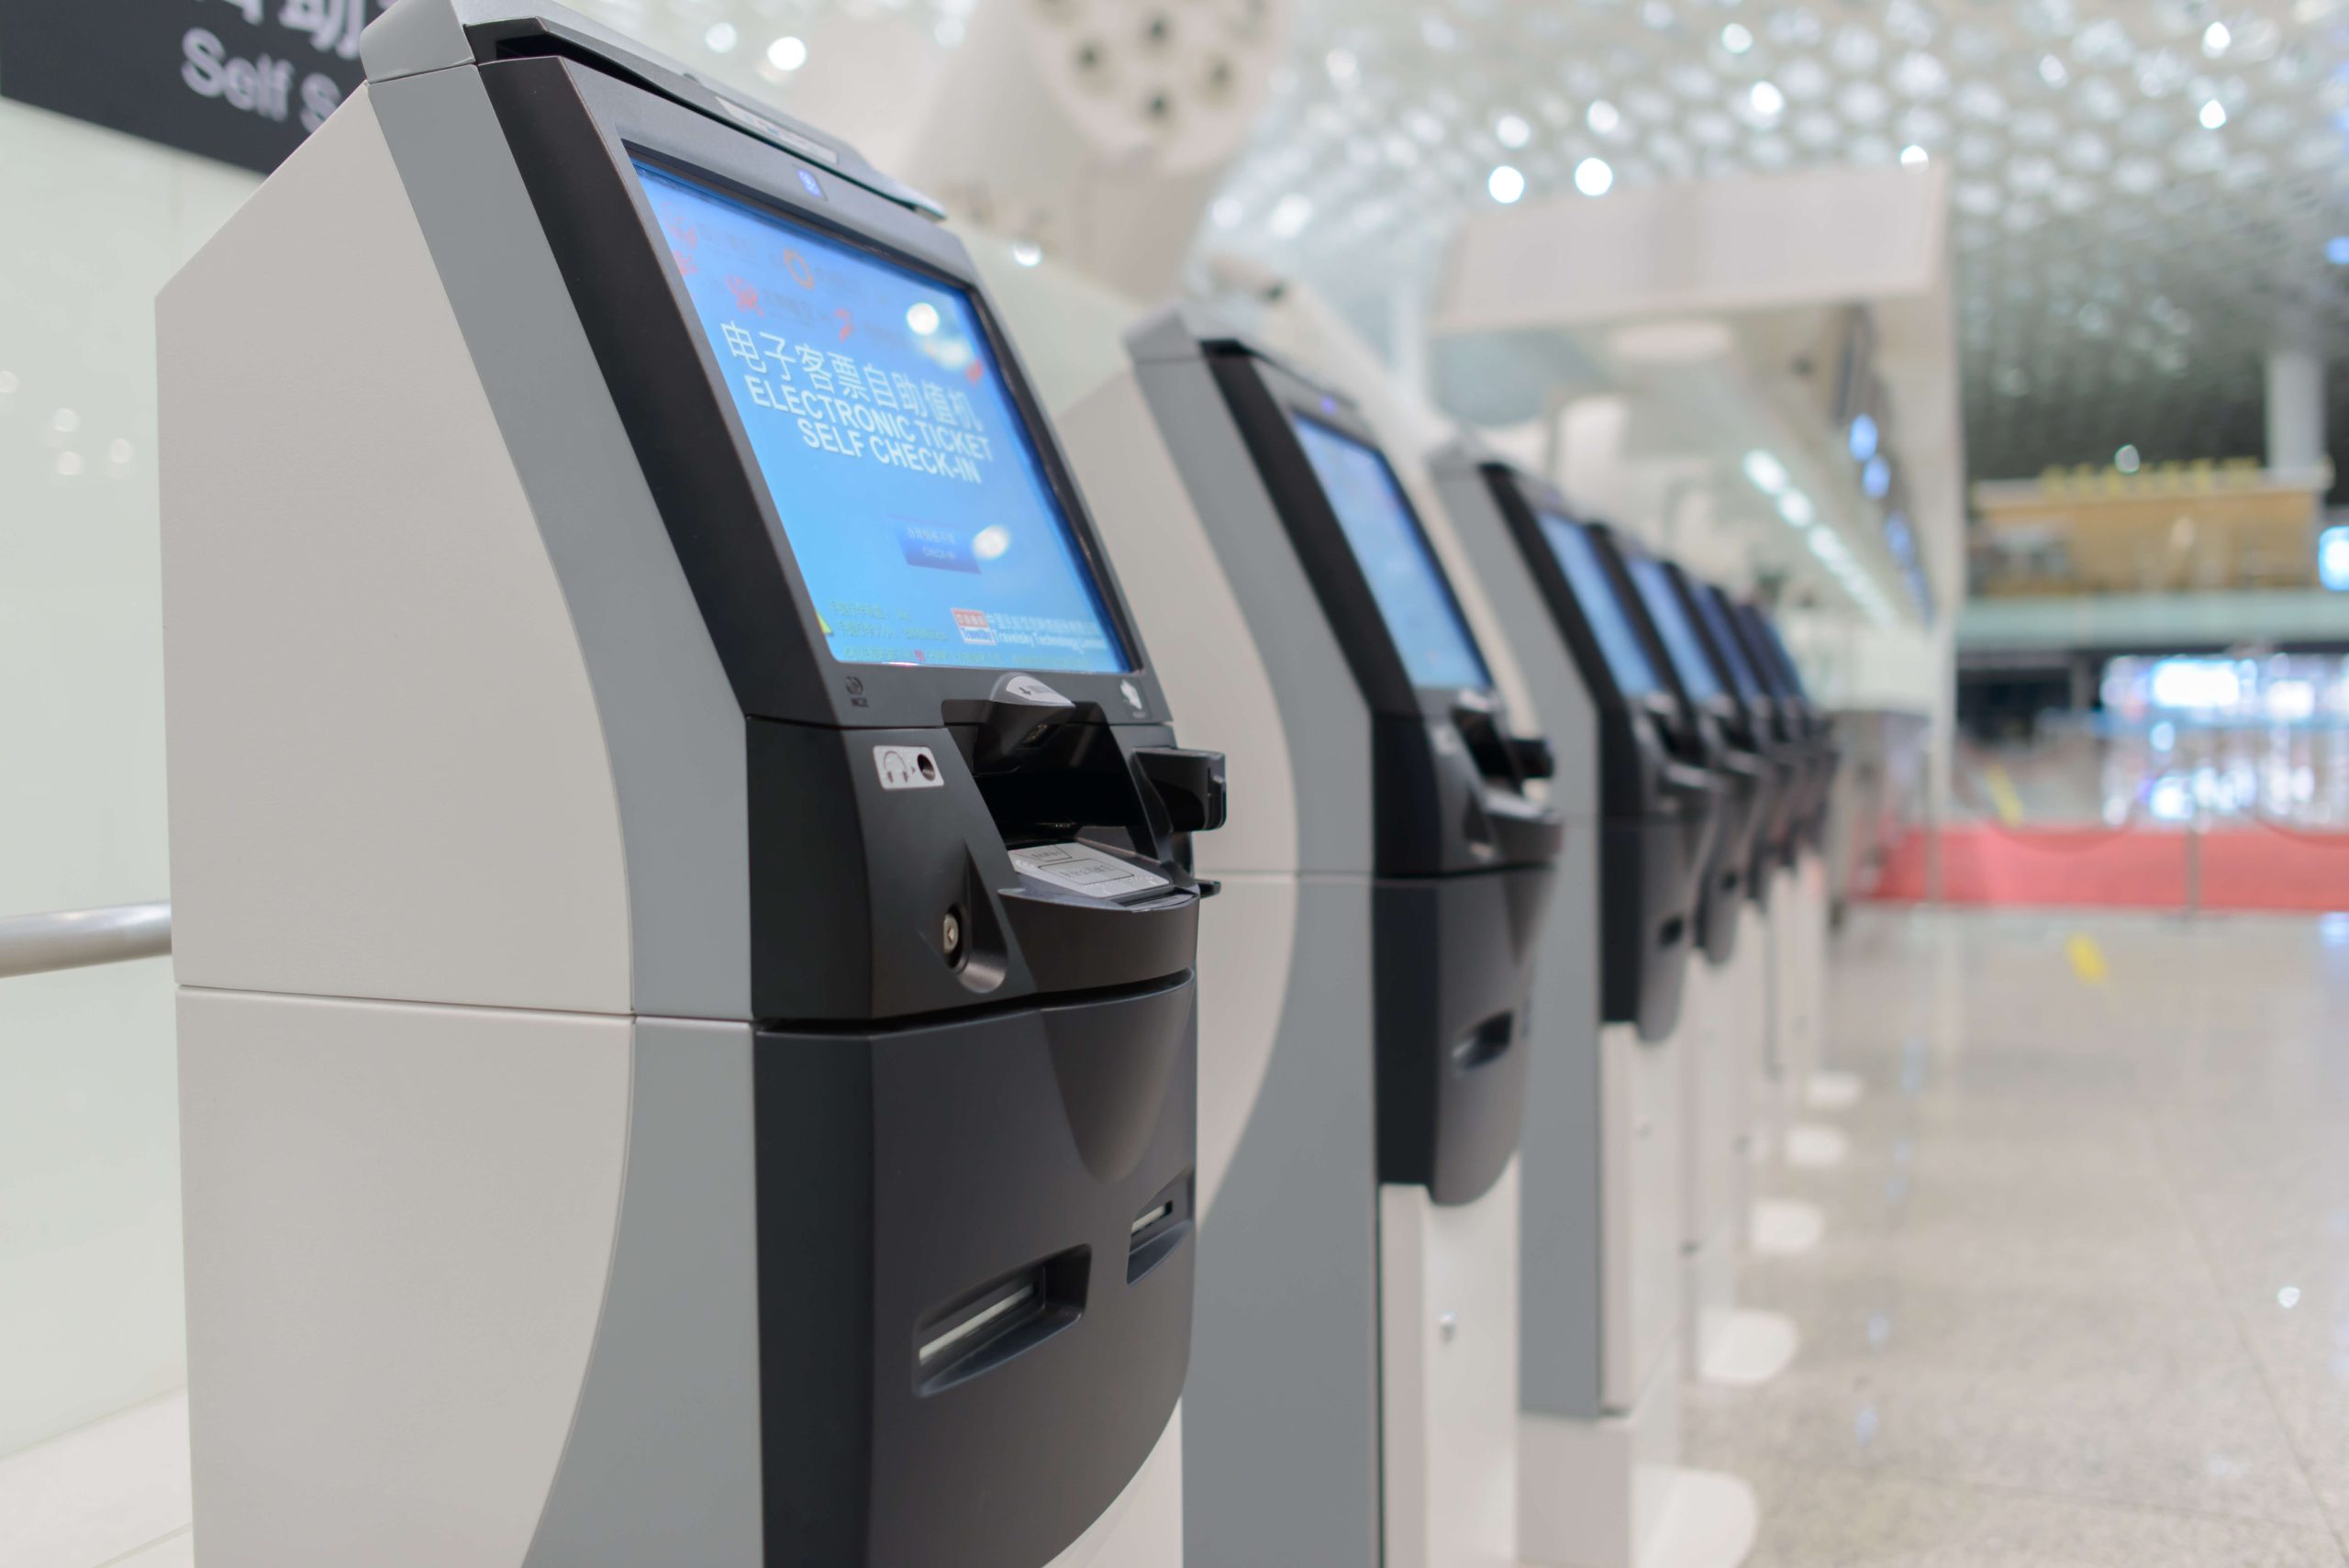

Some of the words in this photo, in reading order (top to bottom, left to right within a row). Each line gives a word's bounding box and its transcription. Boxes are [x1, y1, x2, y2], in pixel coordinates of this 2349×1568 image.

[182, 27, 294, 122] Self
[721, 320, 984, 432] 电子客票自助值机
[746, 375, 916, 442] ELECTRONIC
[914, 419, 994, 462] TICKET
[797, 417, 864, 457] SELF
[870, 435, 982, 484] CHECK-IN
